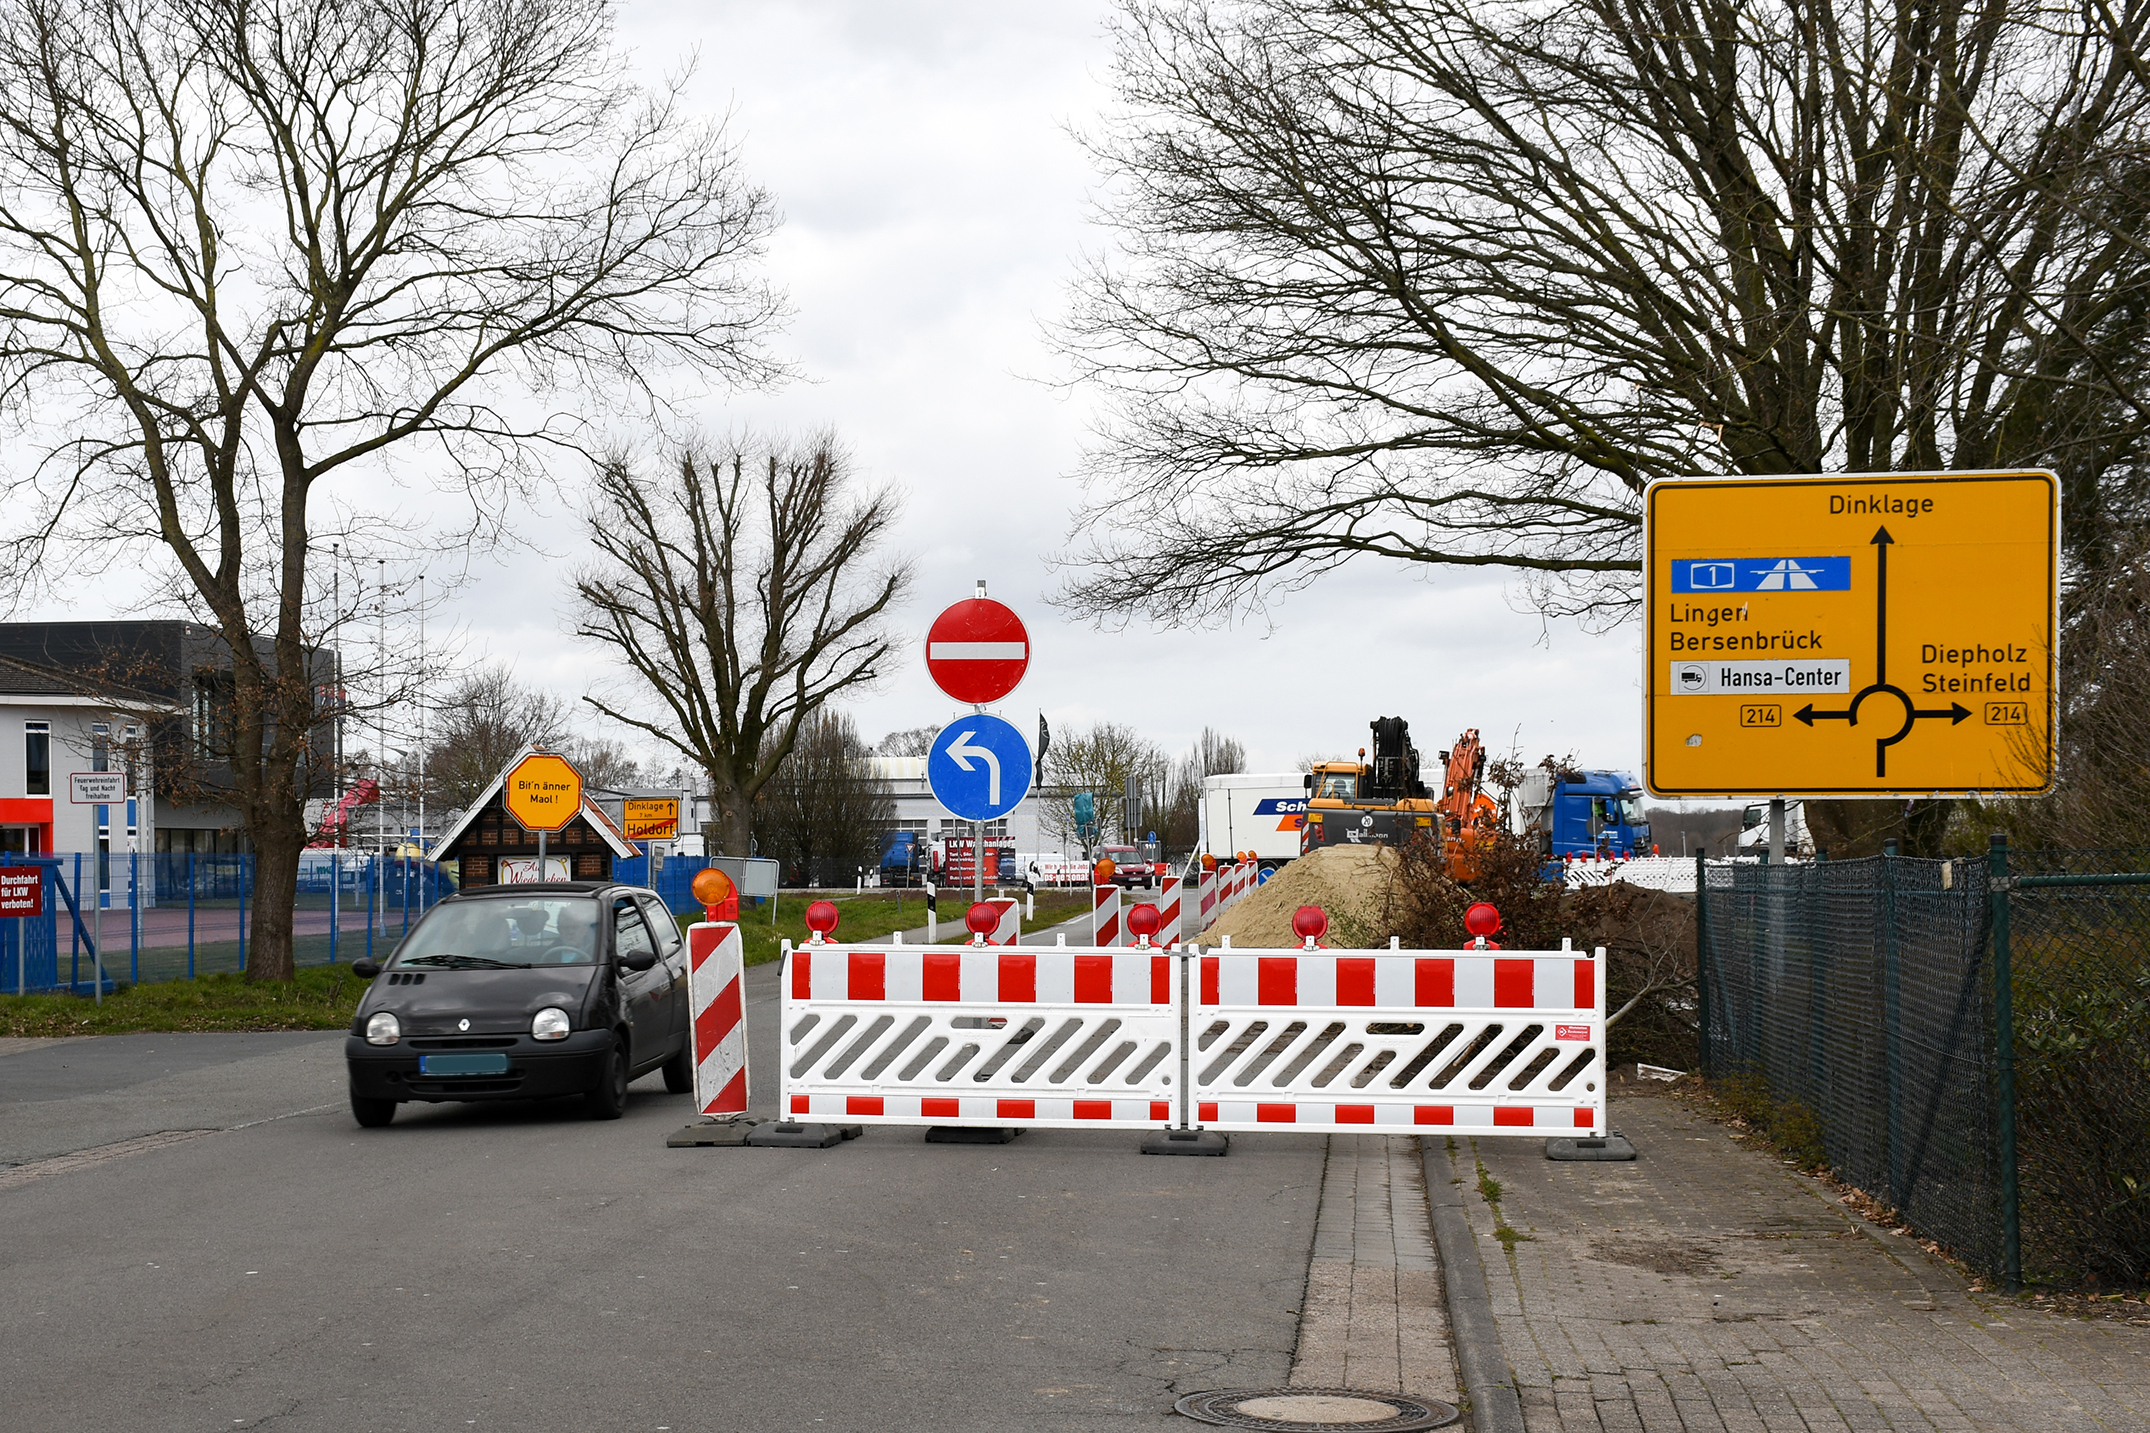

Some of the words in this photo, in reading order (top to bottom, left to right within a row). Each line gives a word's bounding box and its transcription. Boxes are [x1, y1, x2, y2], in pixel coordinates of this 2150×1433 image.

[1829, 494, 1934, 518] Dinklage
[1708, 566, 1716, 586] 1
[1670, 603, 1748, 627] Lingen
[1670, 630, 1823, 651] Bersenbrück
[1922, 643, 2027, 668] Diepholz
[1720, 666, 1842, 687] Hansa-Center
[1922, 672, 2030, 692] Steinfeld
[1746, 708, 1776, 723] 214
[1991, 706, 2021, 721] 214
[74, 776, 120, 784] Feuerwehreinfahrt
[542, 781, 571, 791] änner
[79, 785, 88, 793] Tag
[530, 794, 553, 804] Maol
[628, 801, 664, 812] Dinklage
[627, 822, 674, 835] Holdorf
[1, 875, 39, 885] Durchfahrt
[1, 887, 12, 897] für
[13, 886, 29, 897] LKW
[1, 898, 34, 909] verboten!
